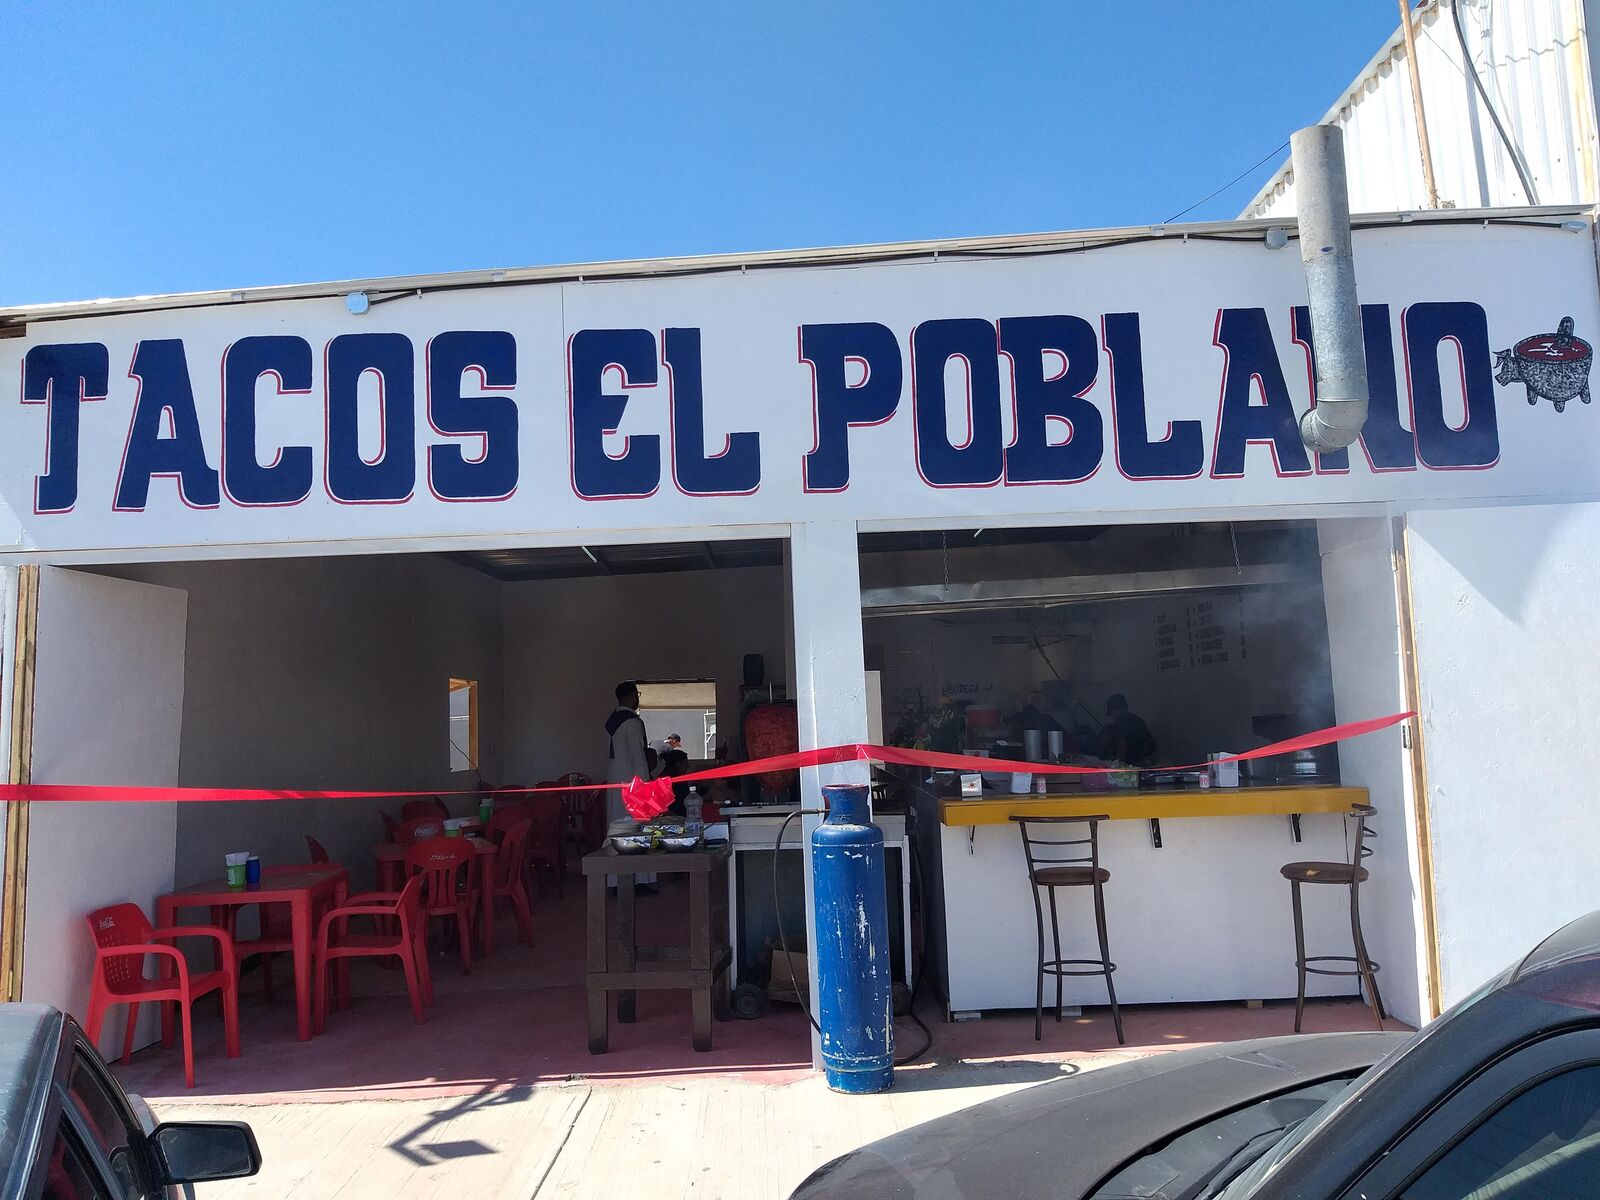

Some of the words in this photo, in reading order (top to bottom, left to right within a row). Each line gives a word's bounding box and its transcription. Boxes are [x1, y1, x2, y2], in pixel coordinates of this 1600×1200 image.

[20, 330, 519, 515] TACOS
[566, 327, 761, 501] EL
[797, 301, 1501, 494] POBLANO
